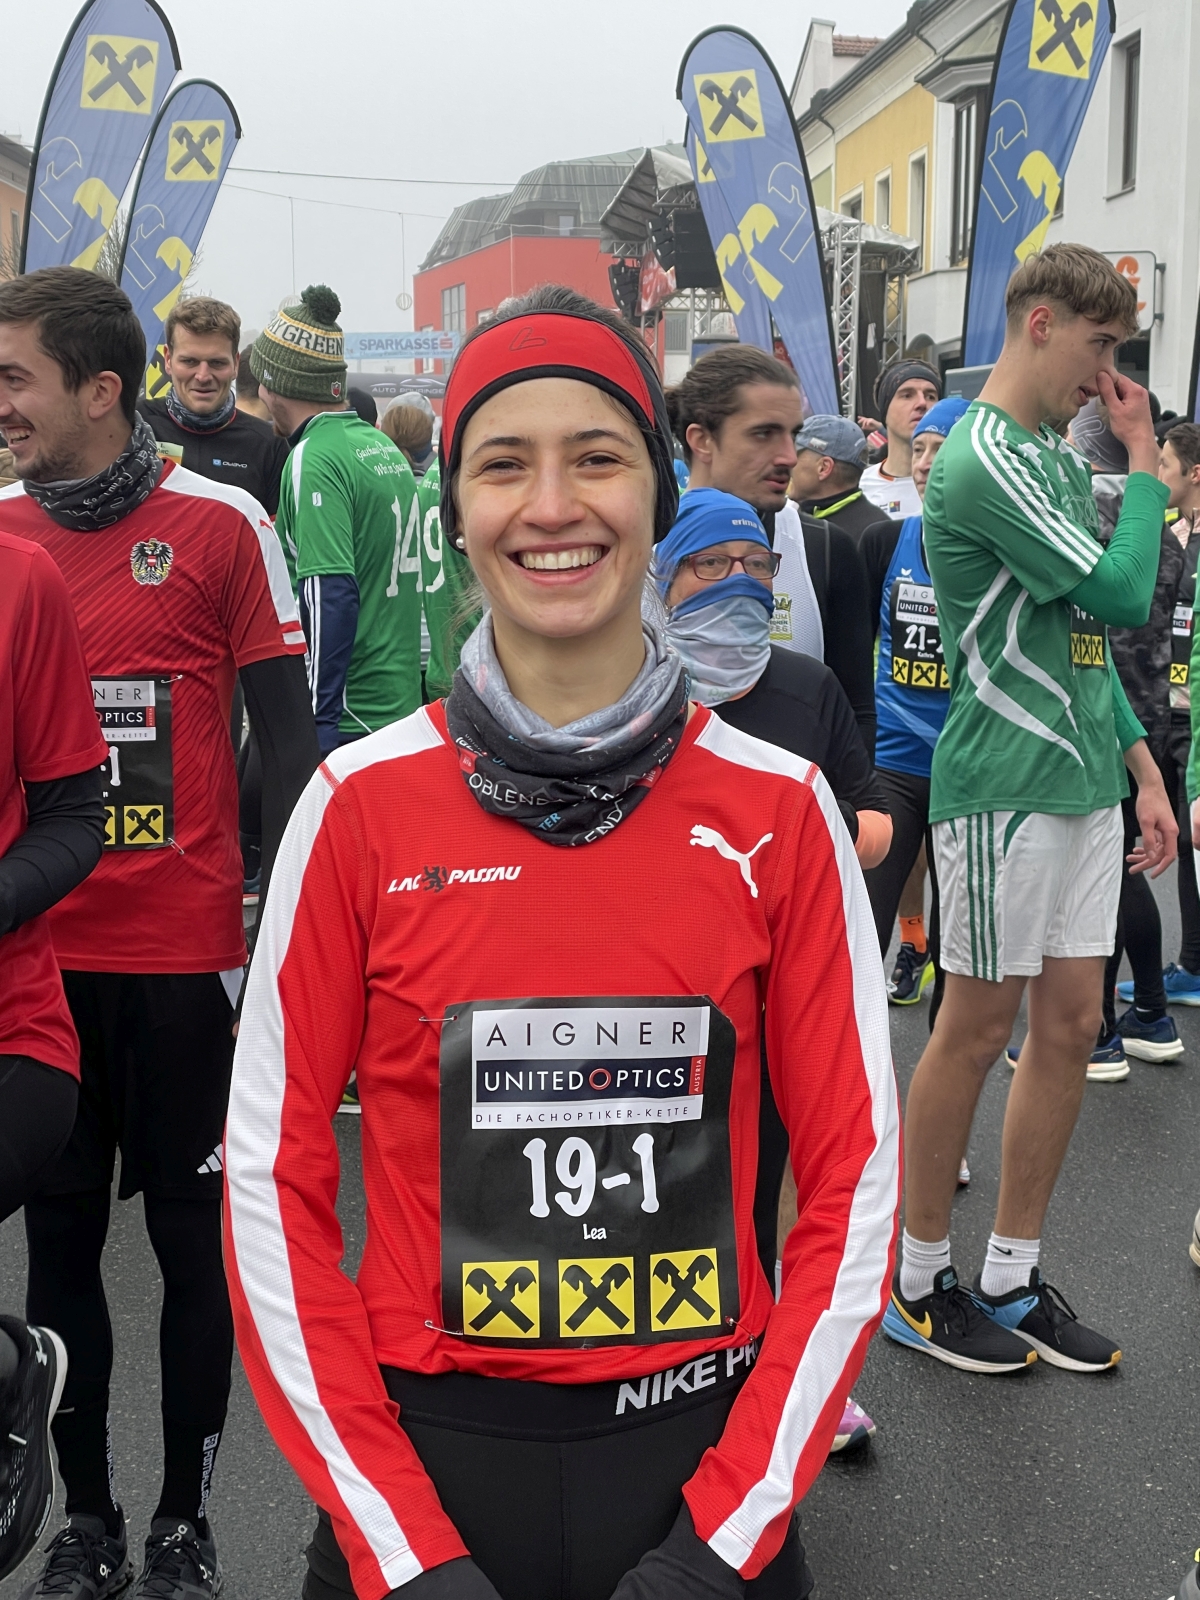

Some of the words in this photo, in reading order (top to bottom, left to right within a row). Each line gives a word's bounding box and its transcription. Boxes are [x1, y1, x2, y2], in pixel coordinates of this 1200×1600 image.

[281, 324, 344, 357] GREEN
[359, 338, 438, 351] SPARKASSE
[731, 518, 758, 529] erima
[902, 588, 929, 599] AIG
[94, 688, 142, 700] NER
[652, 741, 669, 757] union
[386, 873, 422, 894] LAC
[447, 866, 522, 885] PASSAU
[486, 1021, 686, 1047] AIGNER
[693, 1059, 702, 1092] AUSTRIA
[475, 1113, 502, 1123] DIE
[516, 1106, 689, 1123] FACHOPTIKER-KETTE
[522, 1133, 660, 1218] 19-1
[582, 1223, 608, 1241] Lea
[615, 1353, 717, 1416] NIKE
[726, 1341, 760, 1378] PR
